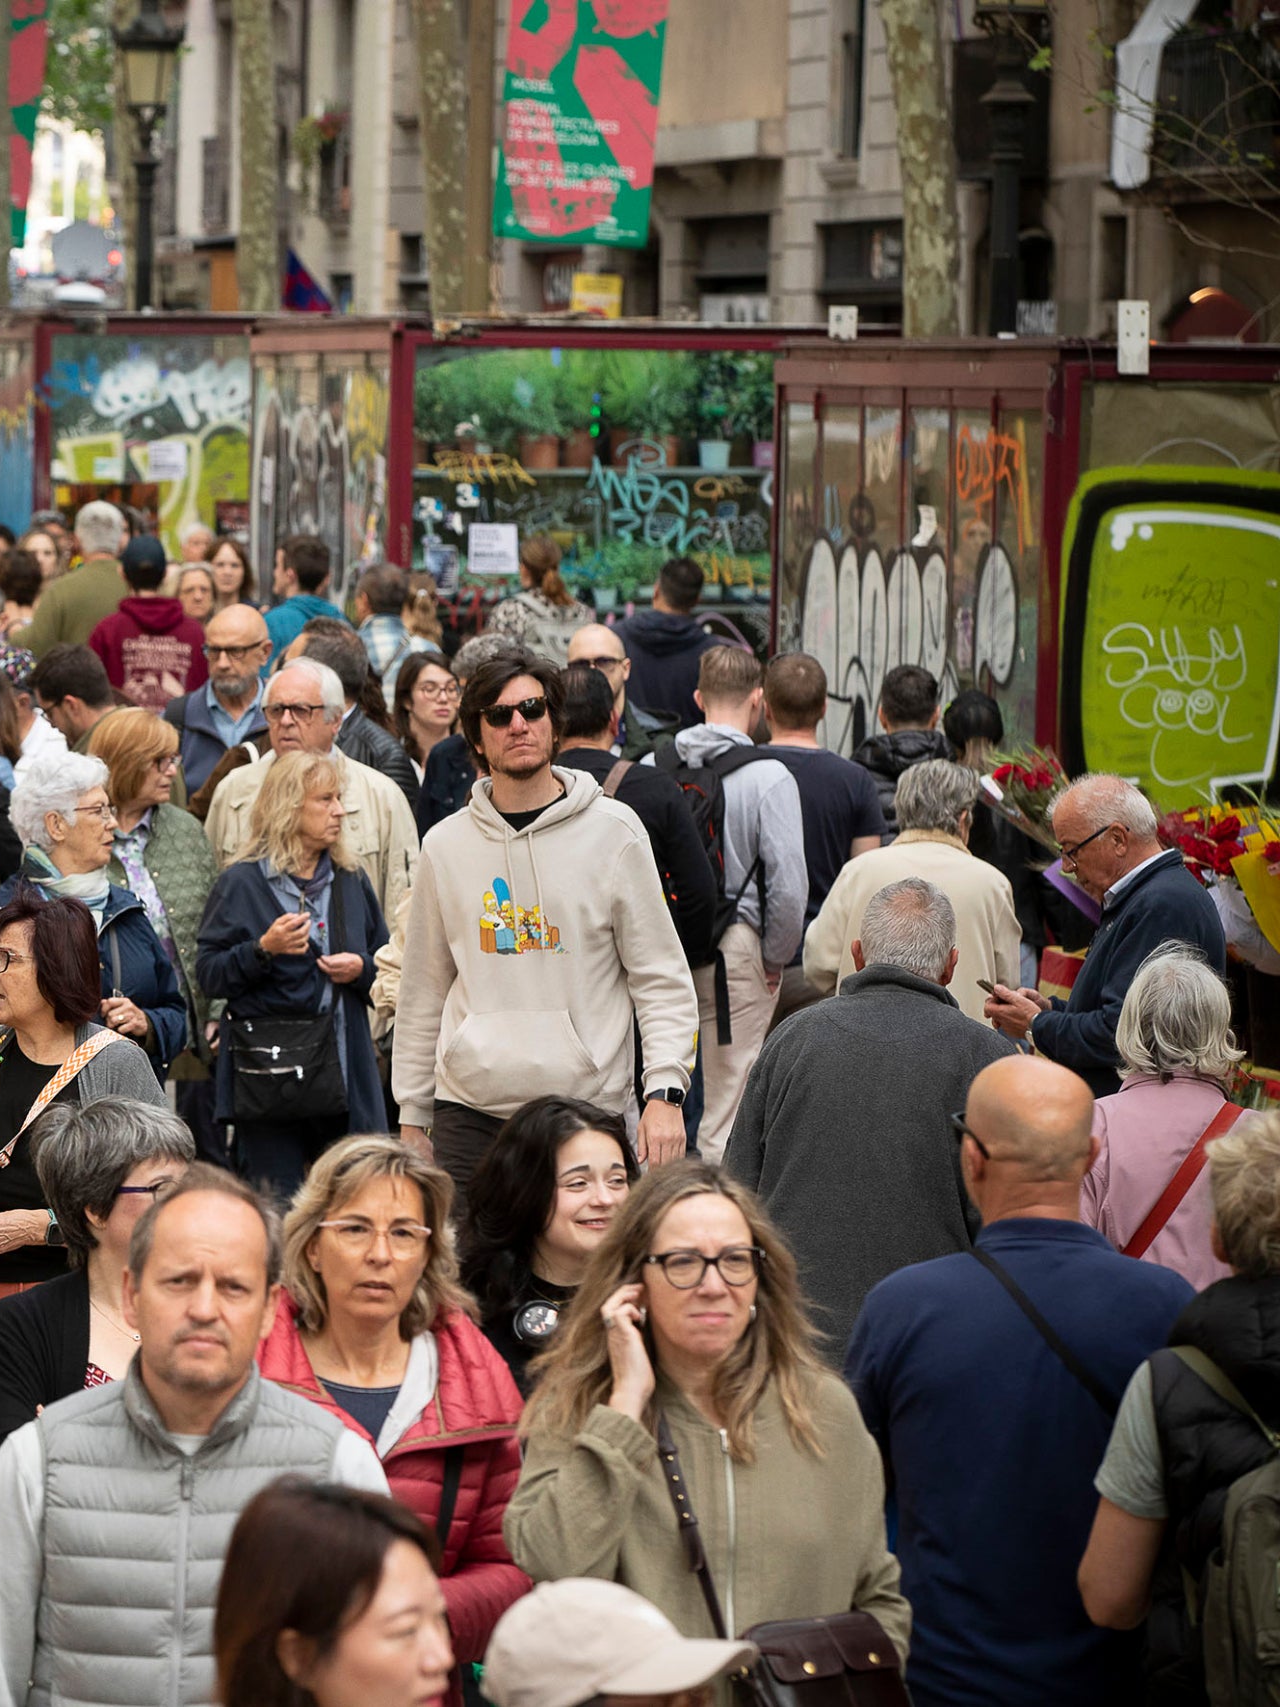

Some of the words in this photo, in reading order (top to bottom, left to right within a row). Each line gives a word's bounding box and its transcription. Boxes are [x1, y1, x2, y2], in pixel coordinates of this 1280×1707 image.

[511, 78, 554, 94] MODEL
[507, 98, 561, 114] FESTIVAL
[506, 127, 526, 141] DE
[526, 129, 600, 146] BARCELONA
[505, 157, 534, 172] PARC
[538, 159, 555, 173] DE
[558, 161, 581, 175] LES
